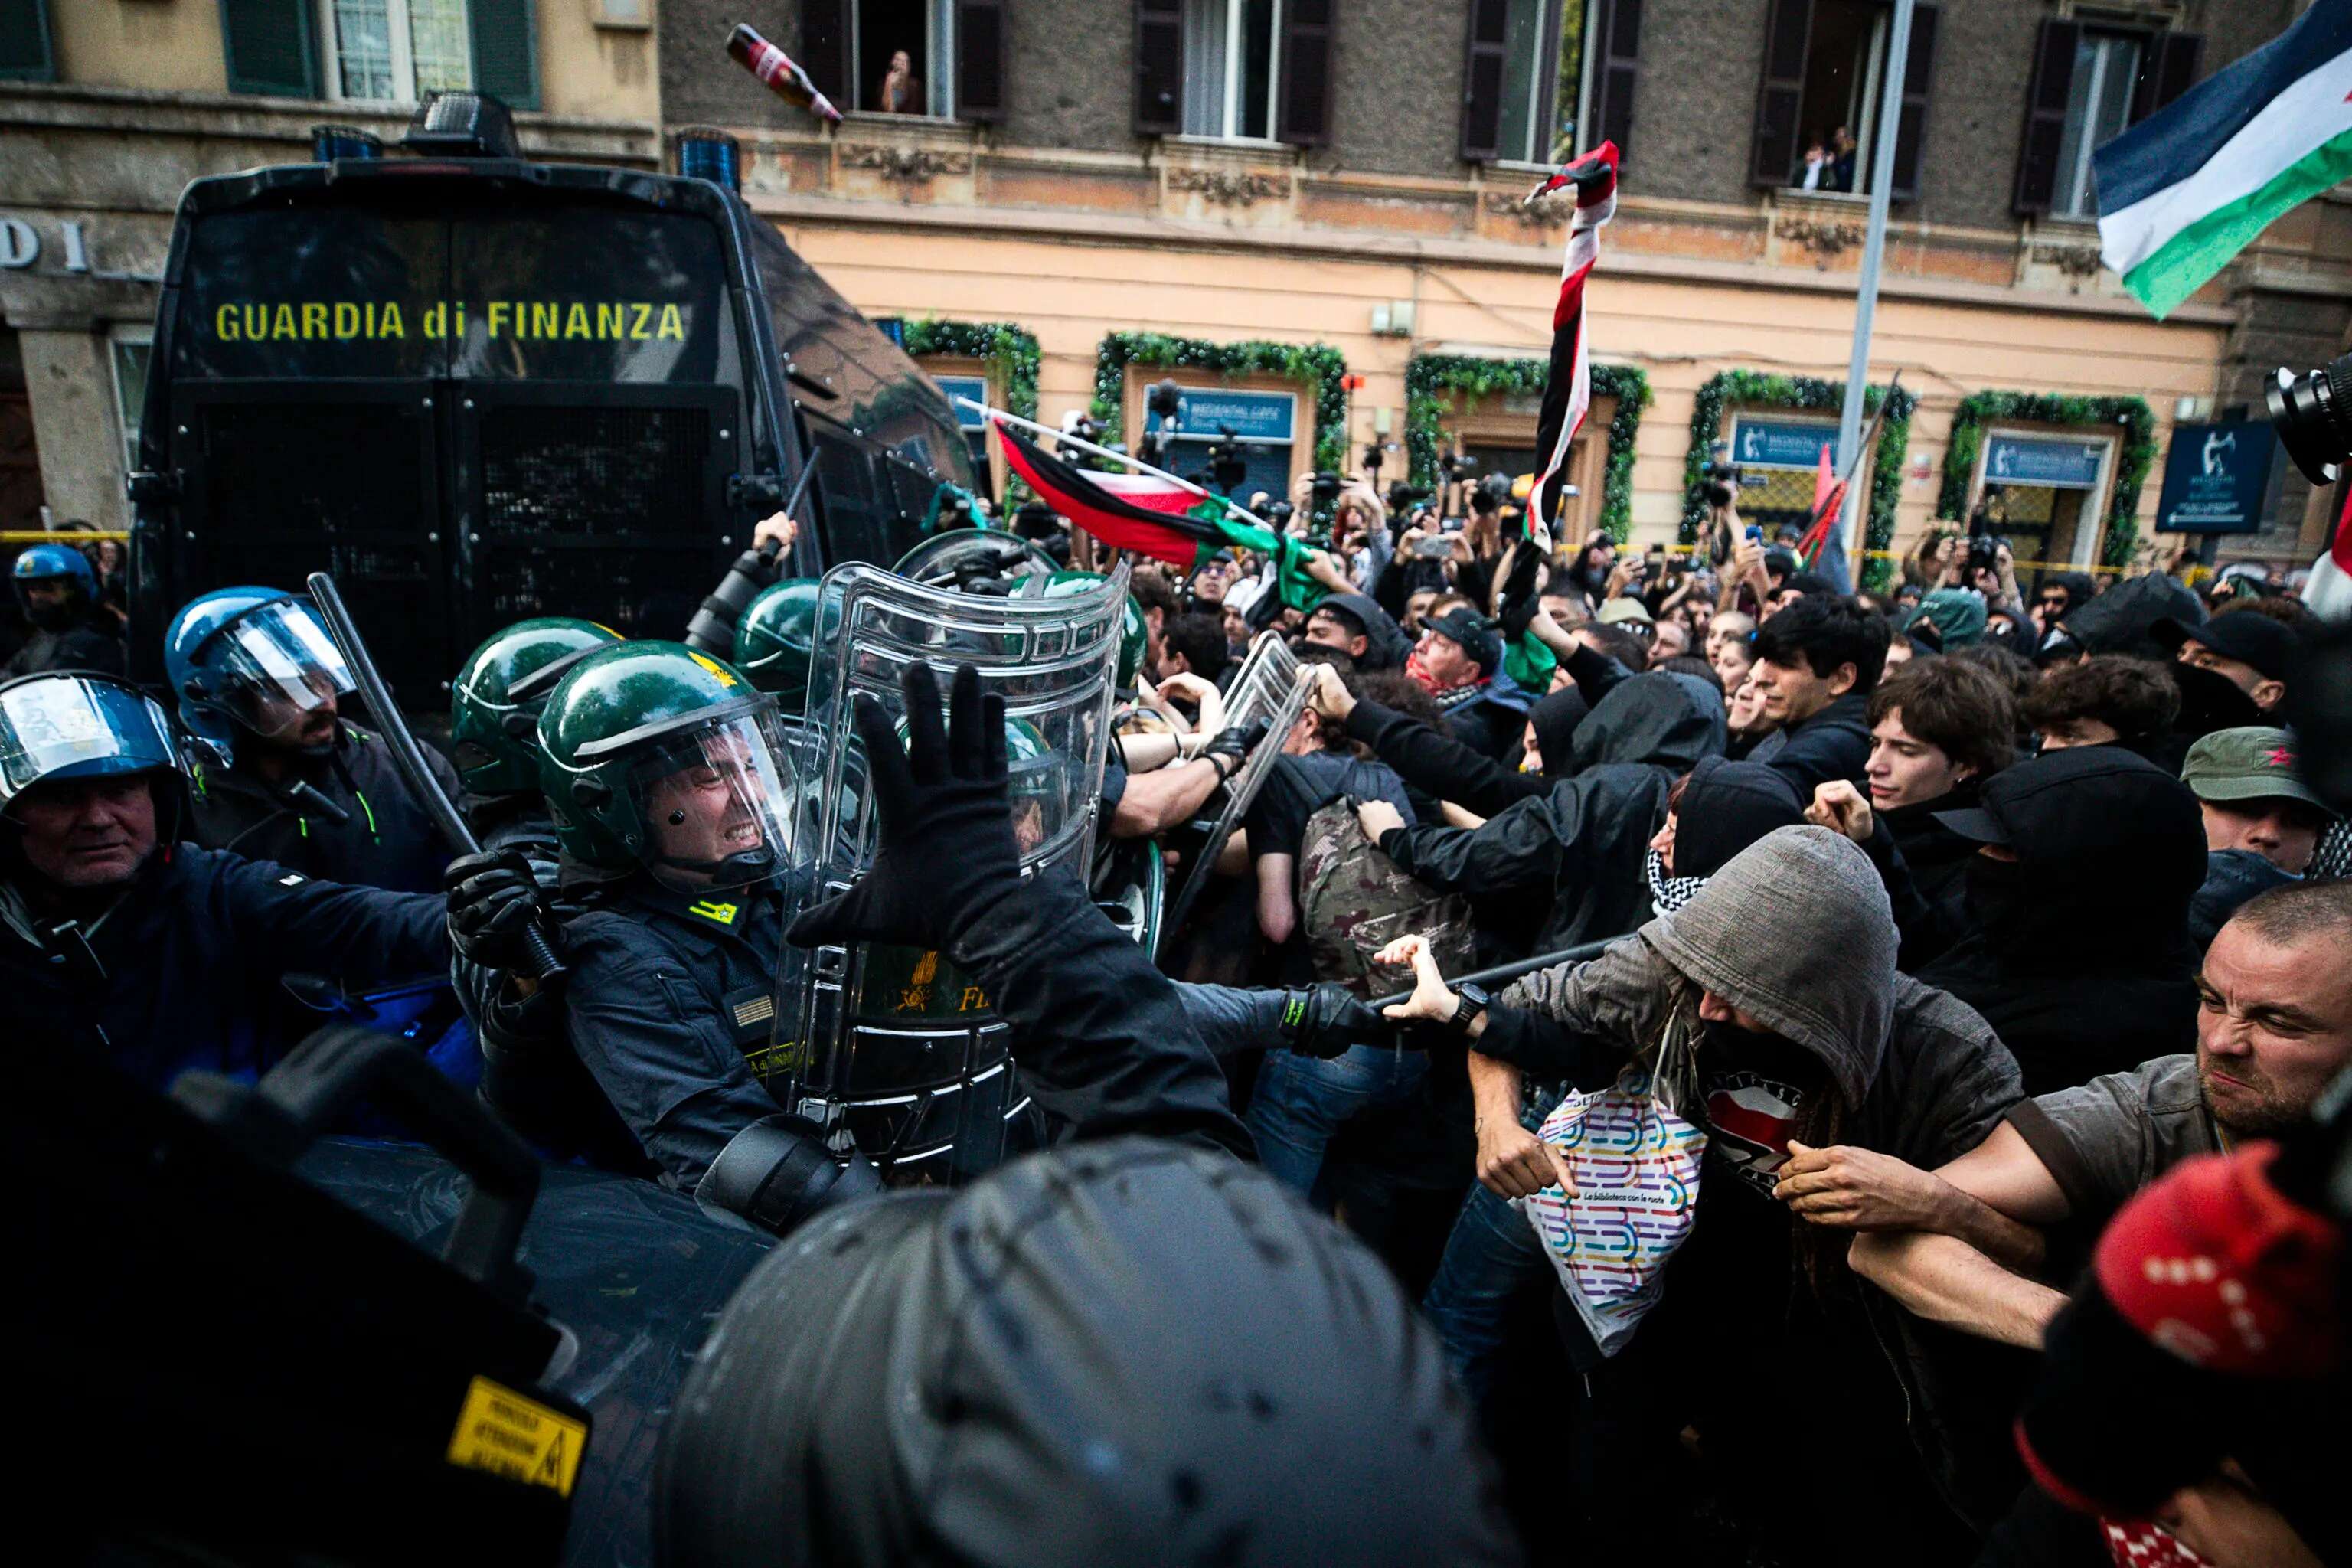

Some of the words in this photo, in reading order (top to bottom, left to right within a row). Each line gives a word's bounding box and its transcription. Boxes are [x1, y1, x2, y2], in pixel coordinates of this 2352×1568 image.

[215, 302, 405, 341] GUARDIA
[423, 300, 465, 340] di
[488, 301, 684, 341] FINANZA
[1583, 1192, 1592, 1200] La
[1592, 1191, 1627, 1201] biblioteca
[1627, 1194, 1640, 1202] con
